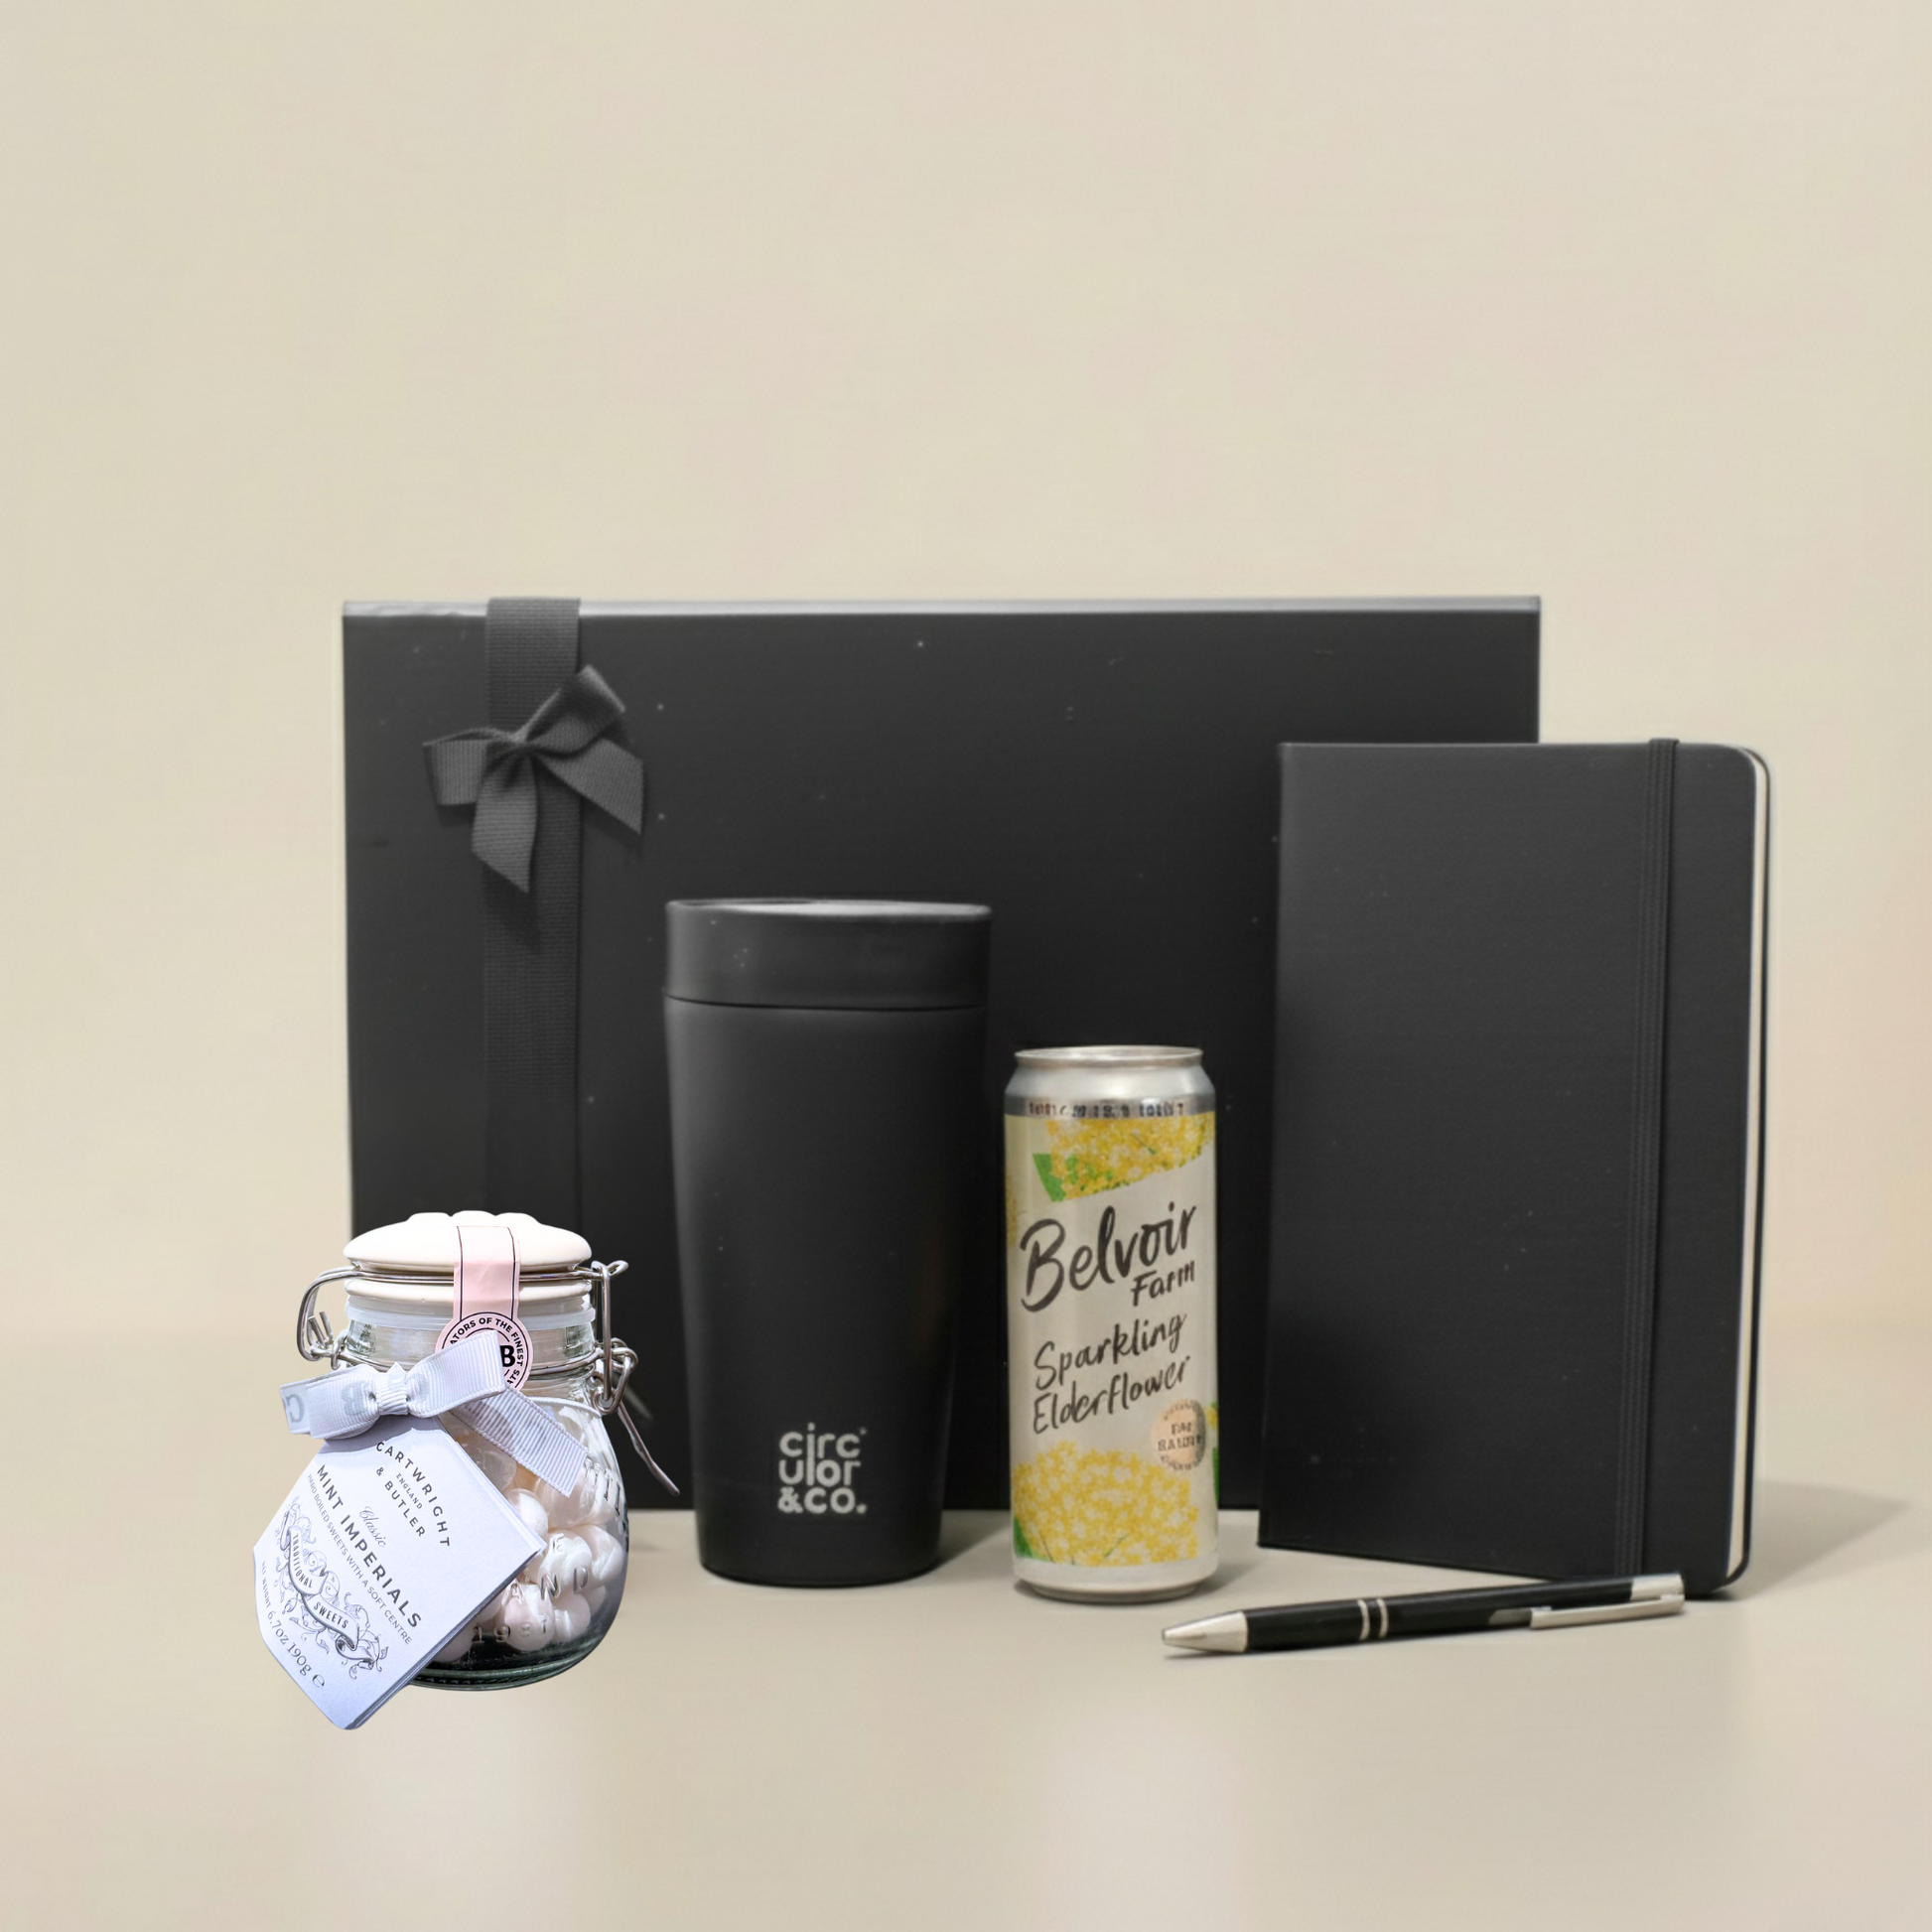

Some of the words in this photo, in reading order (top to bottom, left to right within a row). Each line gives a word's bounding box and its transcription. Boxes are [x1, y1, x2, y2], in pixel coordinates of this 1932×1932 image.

[1019, 1201, 1196, 1312] Belvoir
[1131, 1260, 1195, 1308] Farm
[450, 1319, 477, 1345] ATORS
[495, 1317, 513, 1333] THE
[510, 1331, 524, 1367] FINEST
[1034, 1313, 1187, 1391] Sparkling
[1033, 1355, 1190, 1435] Elderflower
[376, 1441, 450, 1547] CARTWRIGHT
[376, 1466, 384, 1477] &
[384, 1480, 426, 1537] BUTLER
[395, 1472, 423, 1509] ENGLAND
[292, 1533, 313, 1588] TRADITIONAL
[317, 1463, 345, 1510] MINT
[340, 1514, 422, 1628] IMPERIALS
[358, 1505, 386, 1548] Classic
[314, 1493, 330, 1523] BOILED
[327, 1522, 348, 1556] SWEETS
[345, 1555, 364, 1580] WITH
[361, 1579, 368, 1587] A
[367, 1587, 386, 1609] SOFT
[384, 1609, 413, 1645] CENTRE
[314, 1601, 349, 1629] SWEETS
